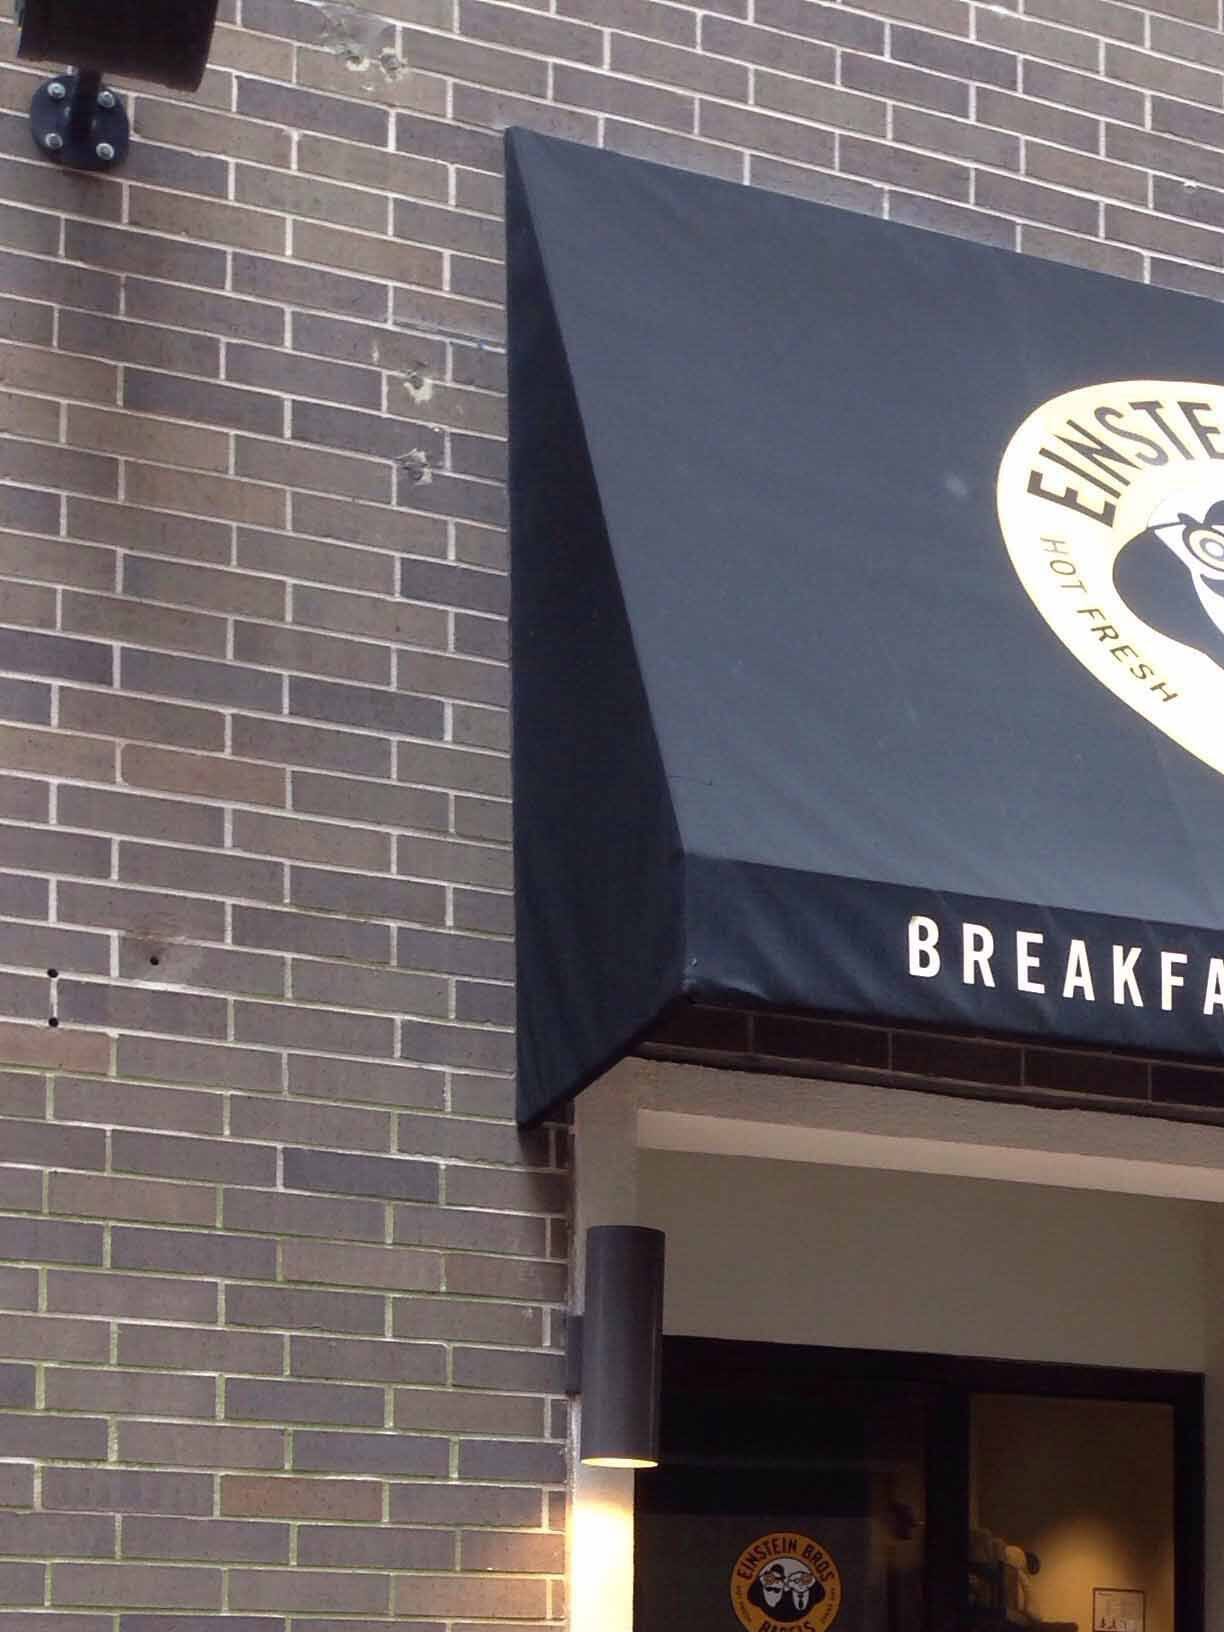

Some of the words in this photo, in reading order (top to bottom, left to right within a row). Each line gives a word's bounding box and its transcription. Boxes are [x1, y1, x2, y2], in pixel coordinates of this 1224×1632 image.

[1039, 536, 1089, 594] HOT
[1076, 608, 1179, 702] FRESH
[737, 1537, 798, 1580] EINSTEIN
[801, 1543, 835, 1583] BROS
